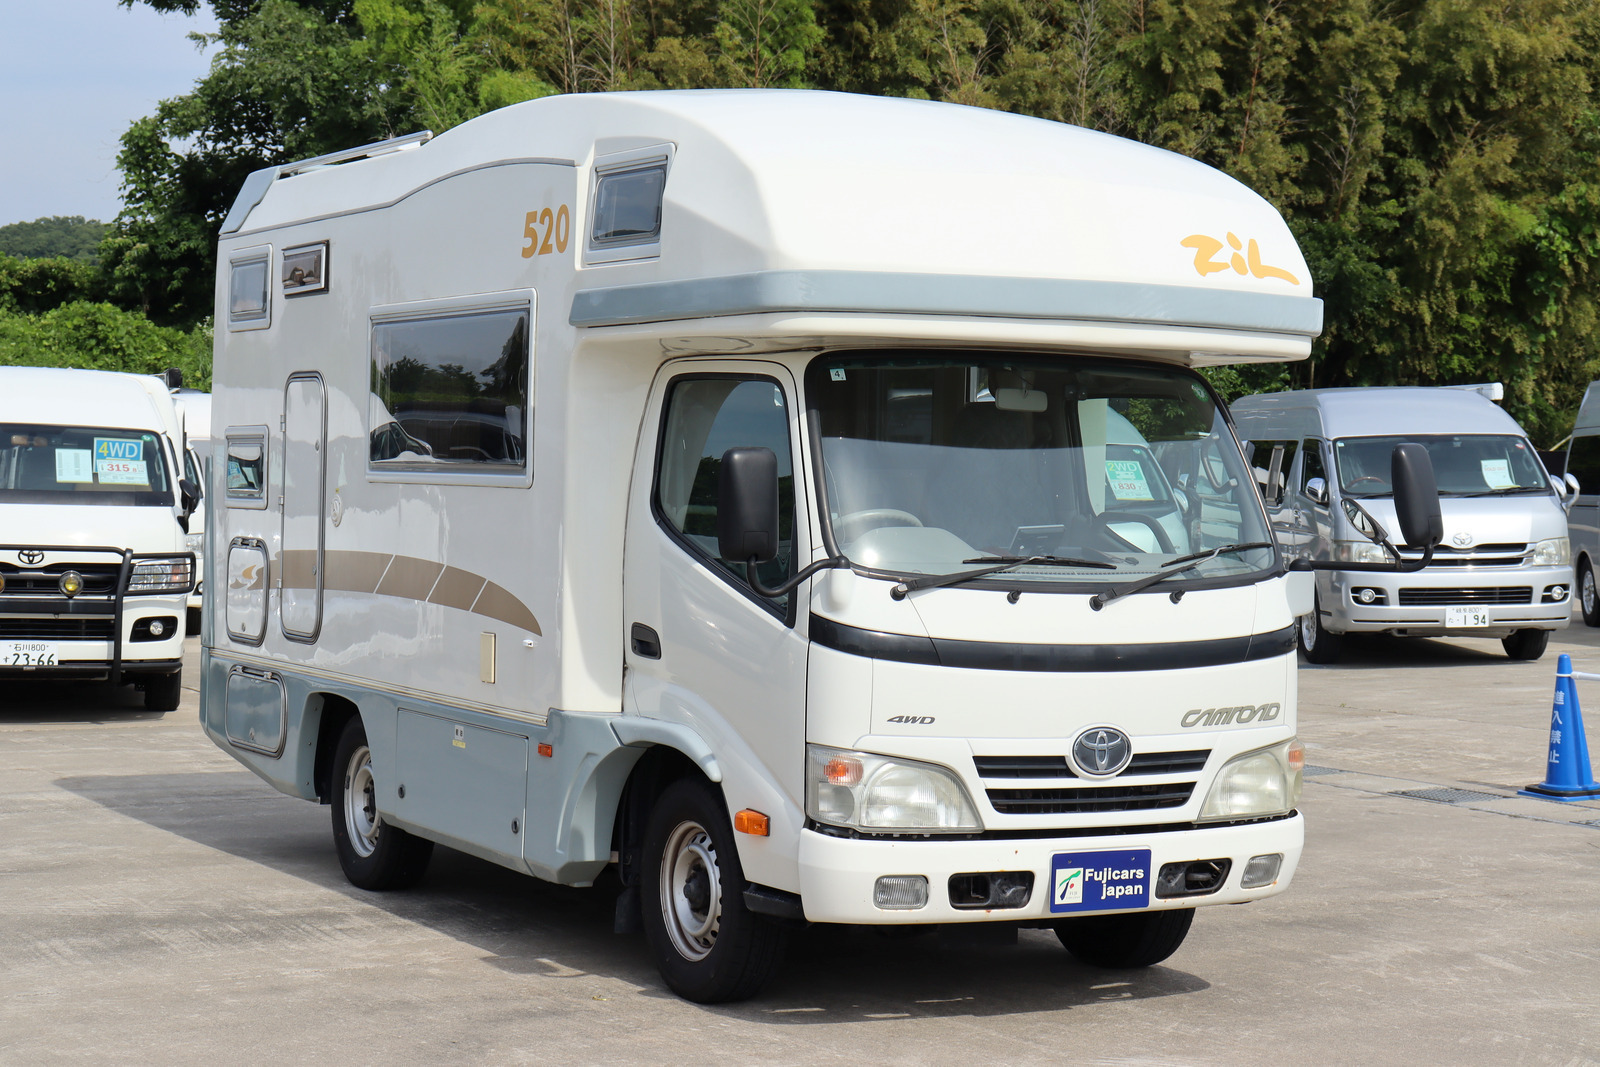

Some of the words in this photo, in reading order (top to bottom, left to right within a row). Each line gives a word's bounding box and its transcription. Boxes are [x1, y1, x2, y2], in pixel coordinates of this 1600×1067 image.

[521, 204, 570, 259] 520
[98, 441, 139, 458] 4WD
[107, 463, 130, 472] 315
[1107, 462, 1138, 472] 2WD
[1118, 482, 1137, 490] 830
[14, 643, 46, 651] 石川800
[12, 652, 55, 666] 23-66
[887, 715, 936, 724] 4WD
[1181, 703, 1280, 727] CAMROAD
[1549, 690, 1565, 764] 進入禁止
[1085, 867, 1145, 884] Fujicars
[1101, 884, 1143, 900] japan
